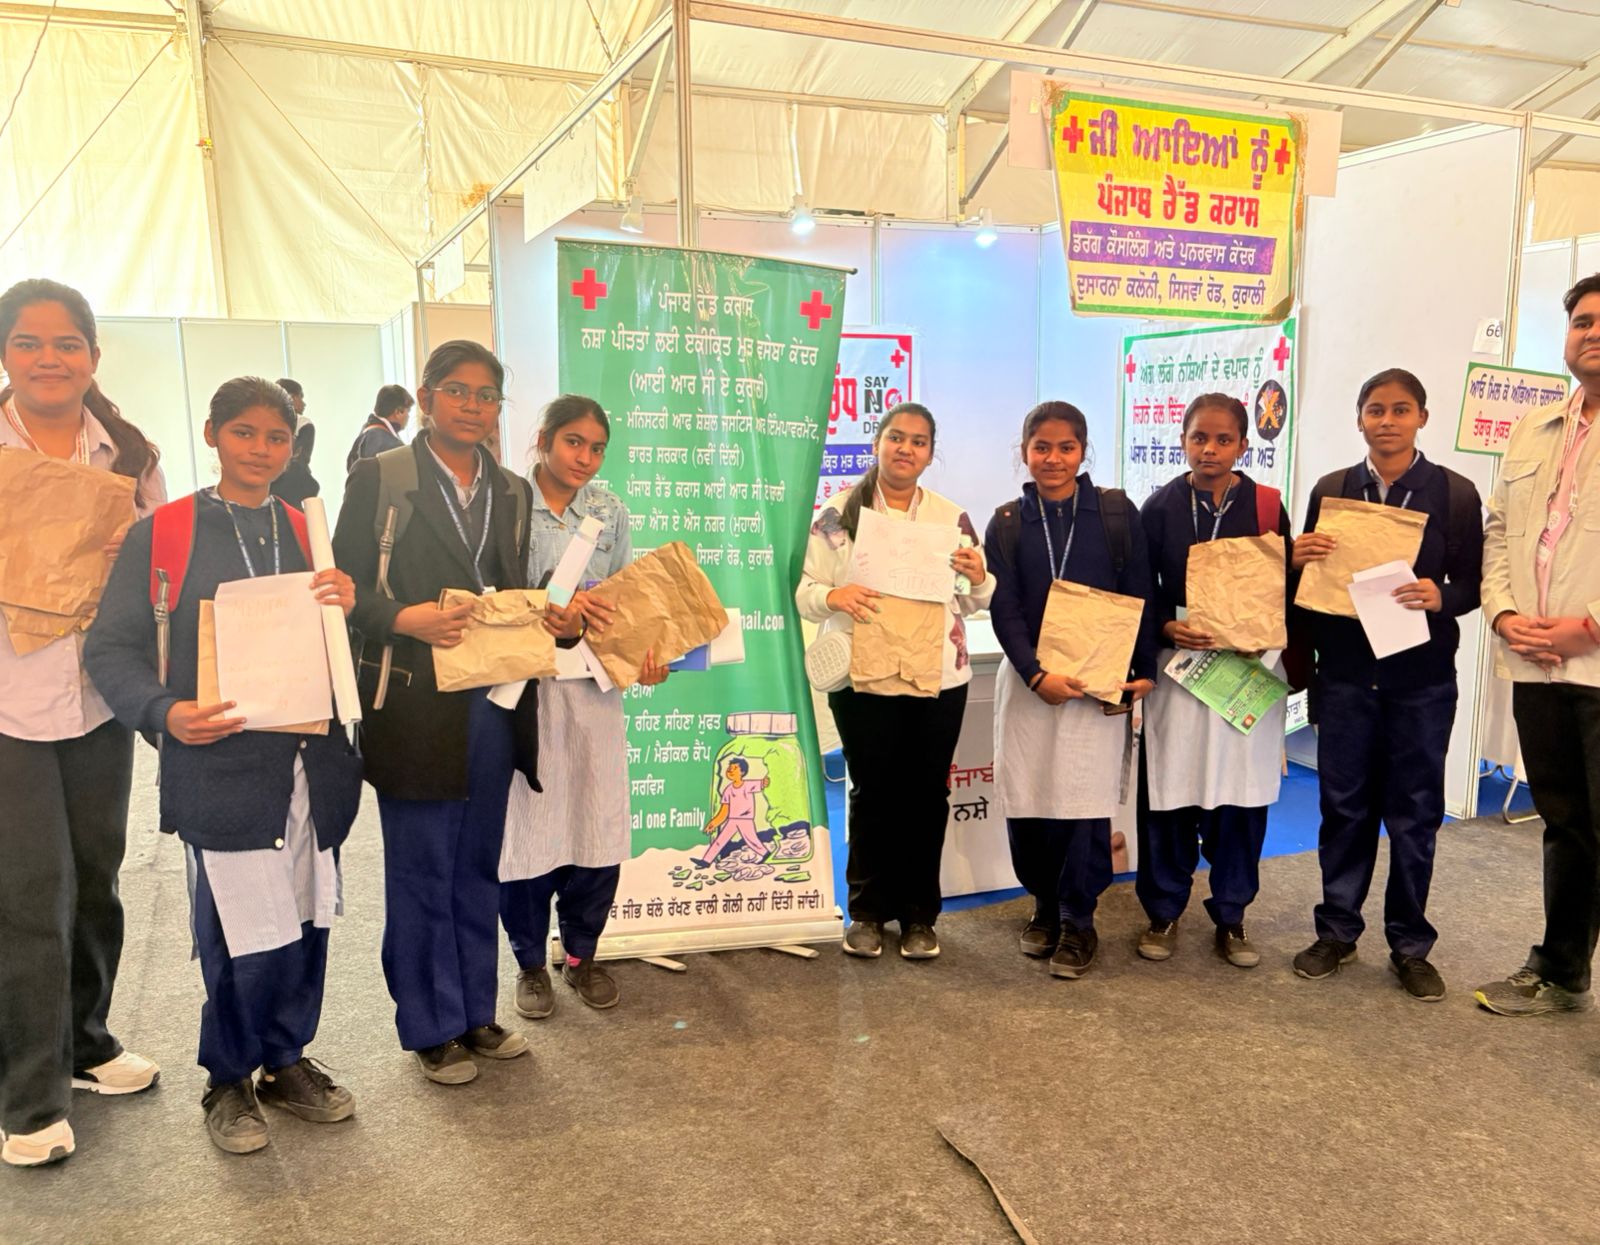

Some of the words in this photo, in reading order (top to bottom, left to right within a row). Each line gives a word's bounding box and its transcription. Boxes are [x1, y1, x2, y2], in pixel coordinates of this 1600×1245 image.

[1088, 109, 1118, 158] ਜੀ
[1132, 118, 1239, 169] ਆਇਆਂ
[1250, 128, 1270, 190] ਨੂੰ
[1097, 173, 1152, 219] ਪੰਜਾਬ
[1162, 174, 1200, 224] ਰੈੱਡ
[1209, 193, 1260, 228] ਕਰਾਸ
[1072, 226, 1102, 254] ਡਰੱਗ
[1154, 234, 1176, 260] ਅਤੇ
[1179, 242, 1226, 266] ਪੁਨਰਵਾਸ
[1229, 239, 1256, 266] ਕੇਂਦਰ
[658, 283, 691, 313] ਪੰਜਾਬ
[1232, 278, 1266, 309] ਕੁਰਾਲੀ
[655, 325, 680, 353] ਲਈ
[789, 336, 819, 366] ਕੇਂਦਰ
[1212, 352, 1221, 380] ਦੇ
[1253, 347, 1264, 389] ਨੂੰ
[671, 374, 697, 395] ਆਰ
[702, 368, 716, 397] ਸੀ
[720, 370, 730, 397] ਏ
[864, 376, 889, 388] SAY
[656, 447, 688, 465] ਸਰਕਾਰ
[1169, 446, 1187, 465] ਕਰਾ
[626, 474, 652, 497] ਪੰਜਾਬ
[675, 481, 701, 498] ਕਰਾਸ
[704, 476, 726, 499] ਆਈ
[729, 483, 749, 499] ਆਰ
[672, 508, 680, 531] ਏ
[705, 516, 726, 532] ਨਗਰ
[631, 773, 665, 796] ਸਰਵਿਸ
[646, 812, 666, 829] one
[670, 807, 706, 831] Family
[952, 796, 989, 821] ਨਸ਼ੇ
[695, 893, 719, 915] ਵਾਲੀ
[722, 892, 743, 913] ਗੋਲੀ
[747, 891, 768, 912] ਨਹੀਂ
[771, 890, 793, 910] ਦਿੱਤੀ
